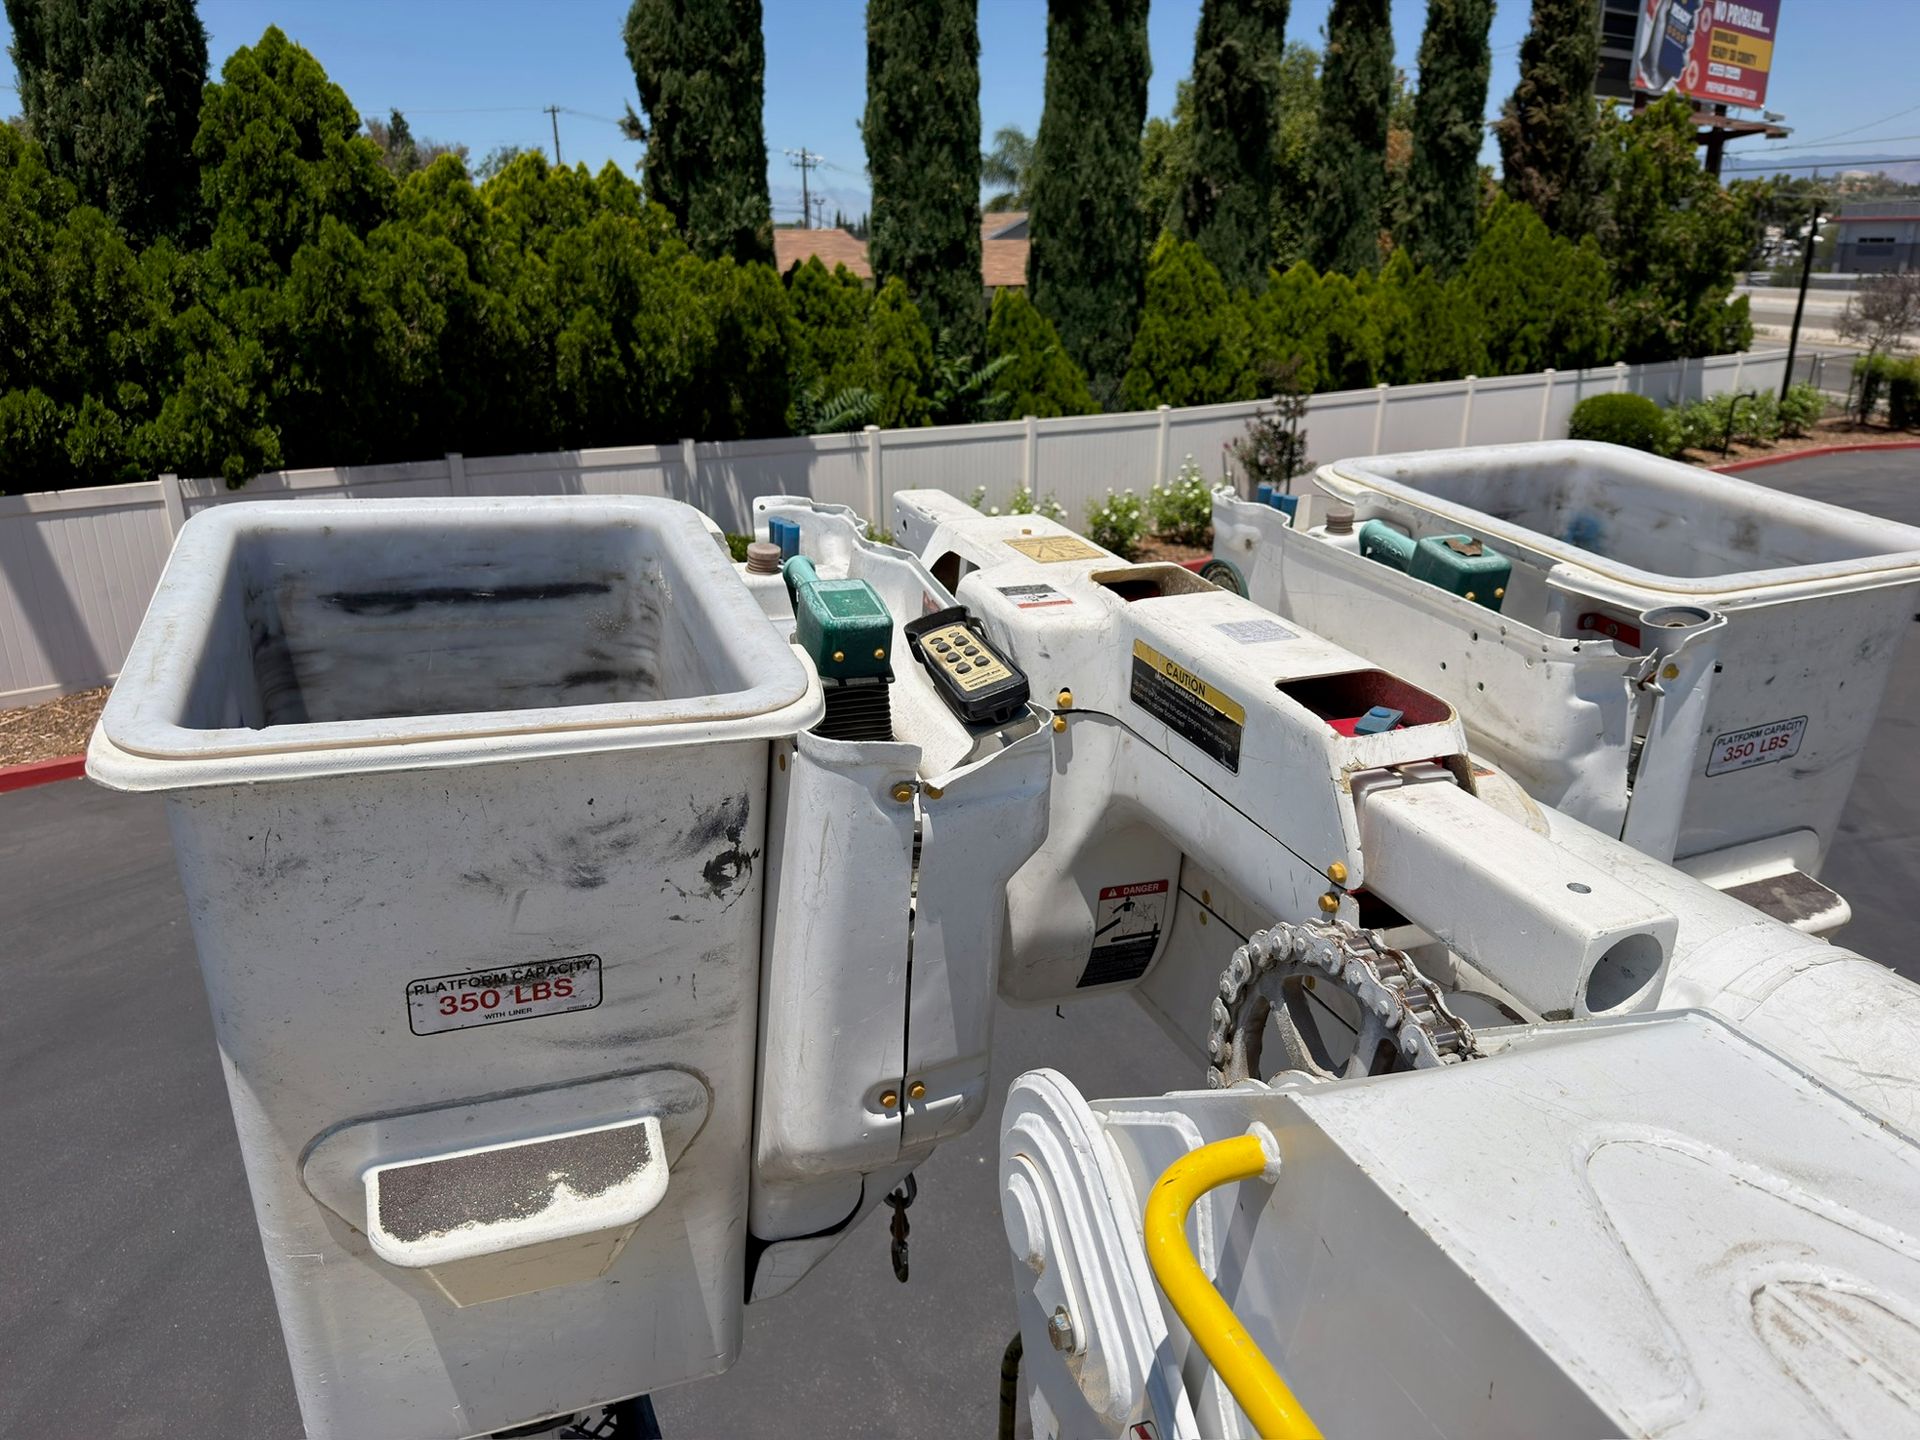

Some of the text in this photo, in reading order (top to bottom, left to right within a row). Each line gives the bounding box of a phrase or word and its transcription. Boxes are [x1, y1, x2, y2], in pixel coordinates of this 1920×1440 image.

[1715, 0, 1727, 21] NO
[1166, 662, 1206, 697] CAUTION
[1717, 720, 1804, 747] PLATFORM CAPACITY
[1723, 734, 1790, 763] 350 LBS
[1123, 883, 1159, 895] DANGER
[414, 959, 594, 996] PLATFORM CAPACITY
[439, 978, 574, 1017] 350 LBS
[484, 1007, 533, 1020] WITH LINER
